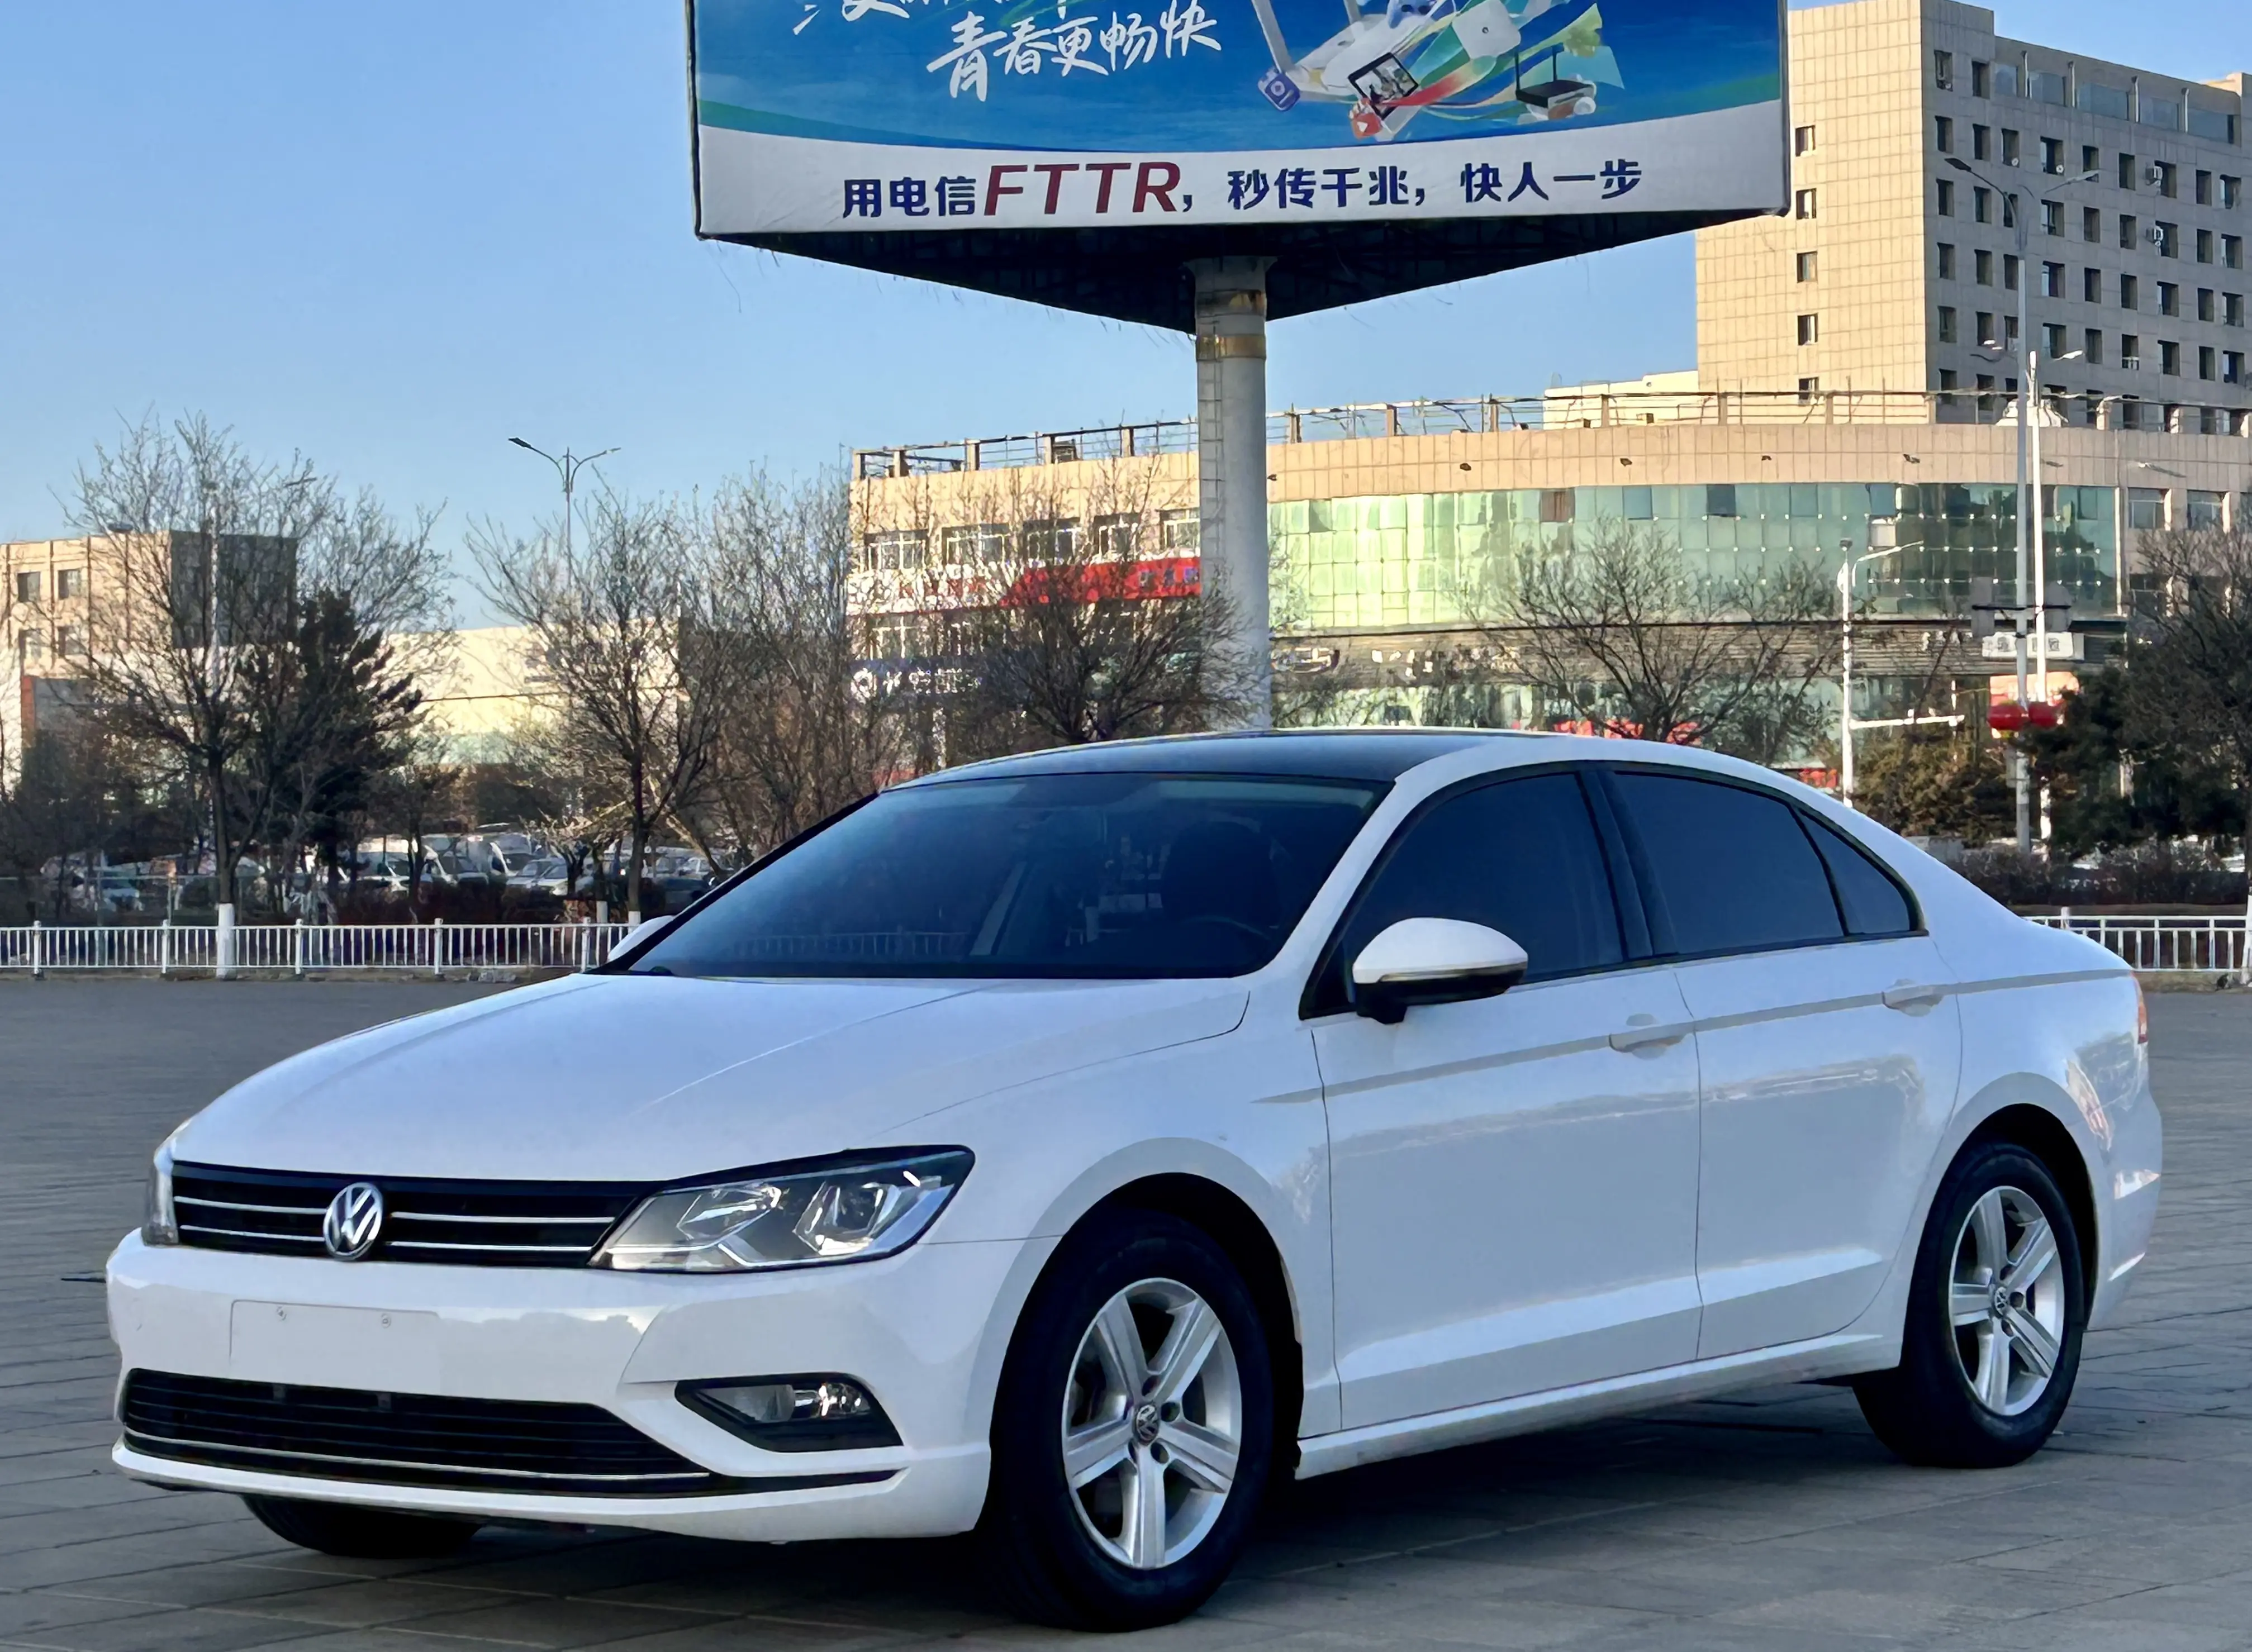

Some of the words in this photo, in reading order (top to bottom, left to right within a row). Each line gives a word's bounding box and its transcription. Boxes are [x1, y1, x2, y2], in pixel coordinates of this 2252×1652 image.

[926, 0, 1222, 102] 青春更畅快
